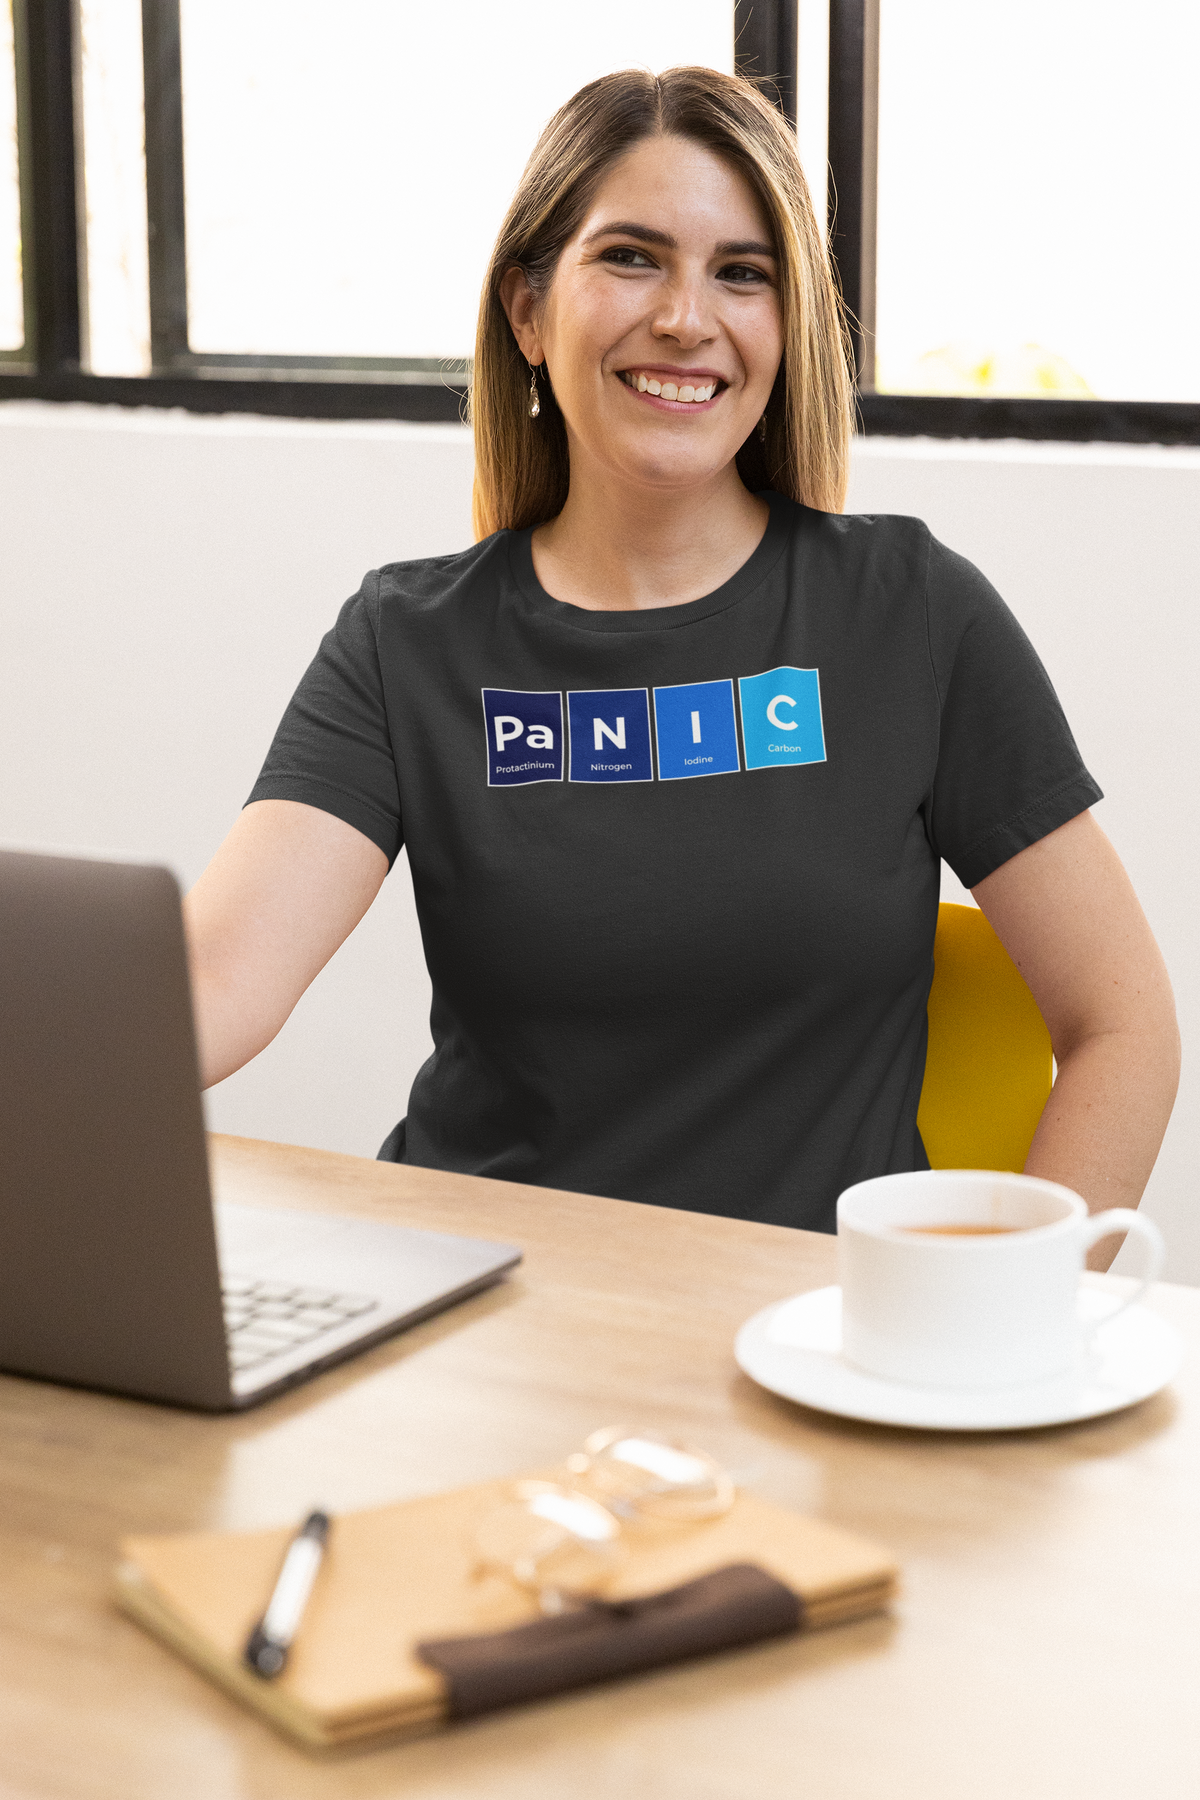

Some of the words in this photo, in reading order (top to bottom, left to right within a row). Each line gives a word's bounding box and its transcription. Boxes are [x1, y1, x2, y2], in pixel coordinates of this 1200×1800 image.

[493, 715, 554, 752] Pa
[593, 716, 627, 751] N
[690, 710, 702, 744] I
[766, 694, 799, 731] C
[495, 761, 556, 774] Protactinium
[590, 763, 633, 772] Nitrogen
[684, 755, 714, 765] Iodine
[767, 743, 803, 753] Carbon
